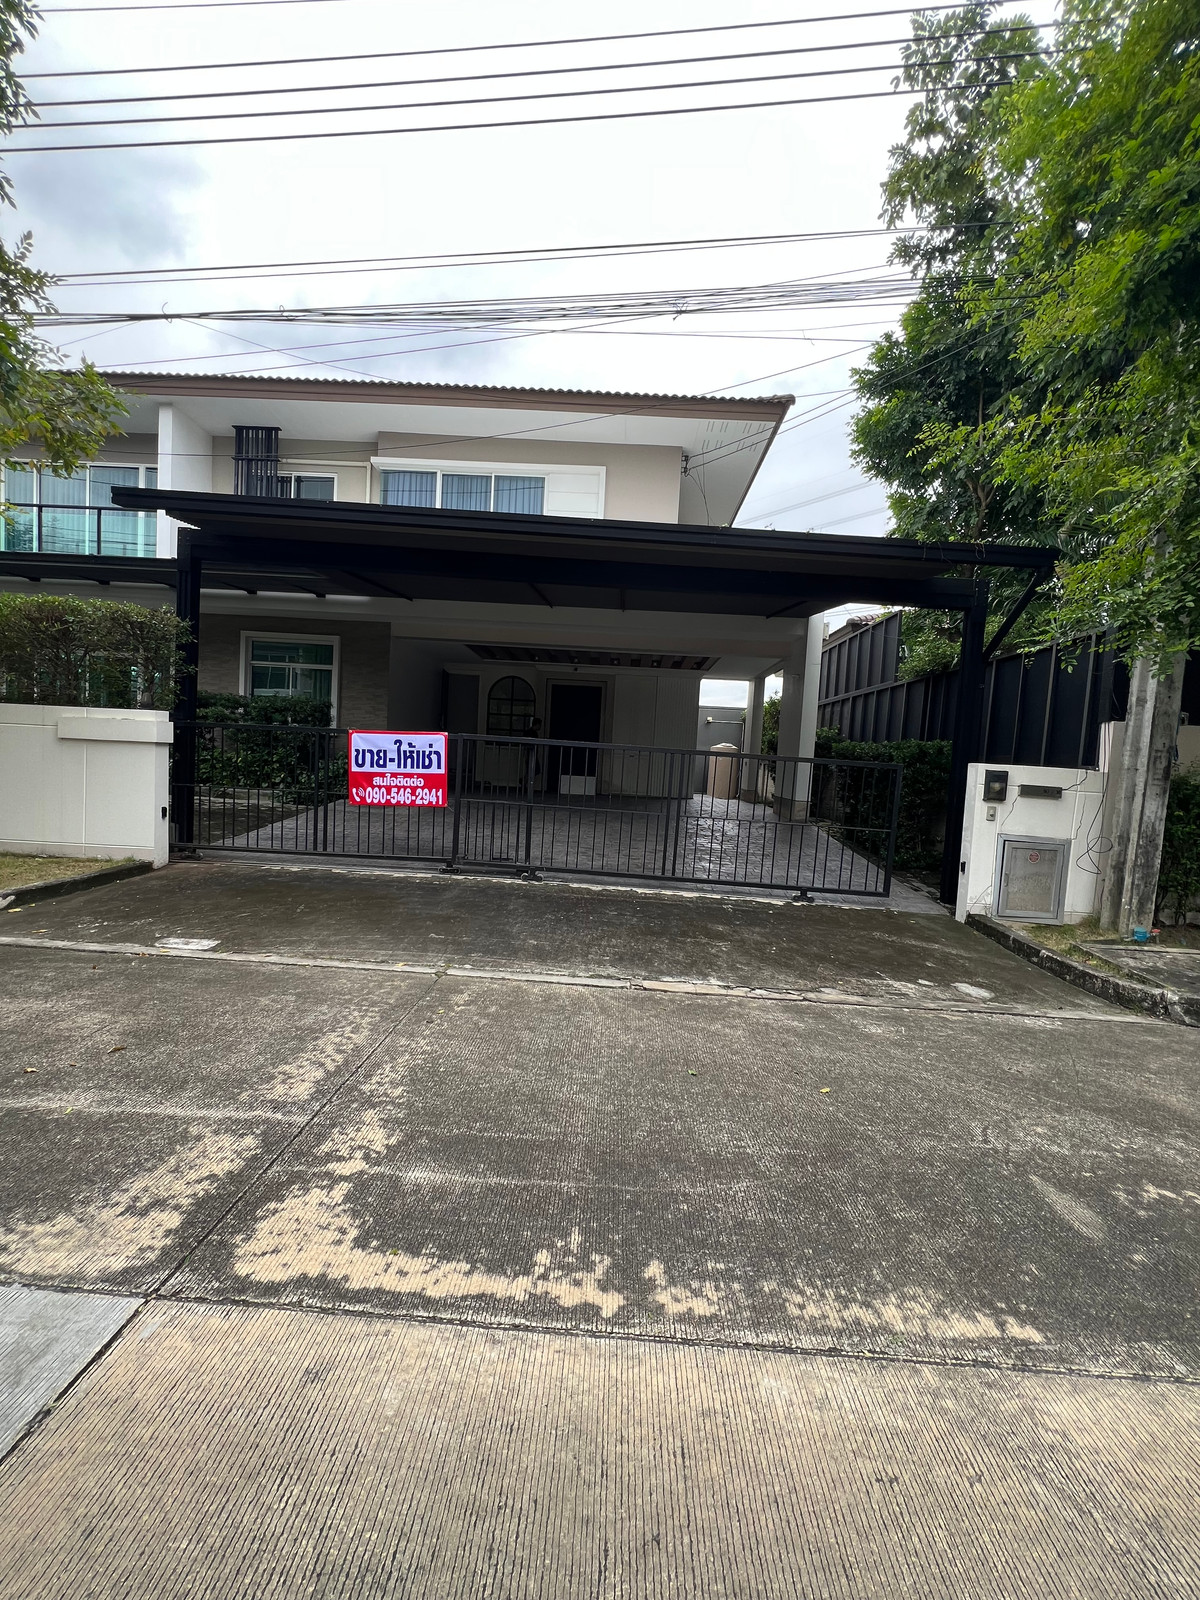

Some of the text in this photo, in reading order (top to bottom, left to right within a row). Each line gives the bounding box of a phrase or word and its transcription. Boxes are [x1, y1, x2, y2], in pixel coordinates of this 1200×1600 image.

[354, 739, 442, 769] ขาย-ให้เช่า
[372, 773, 425, 787] สนใจติดต่อ
[365, 787, 443, 805] 090-546-2941
